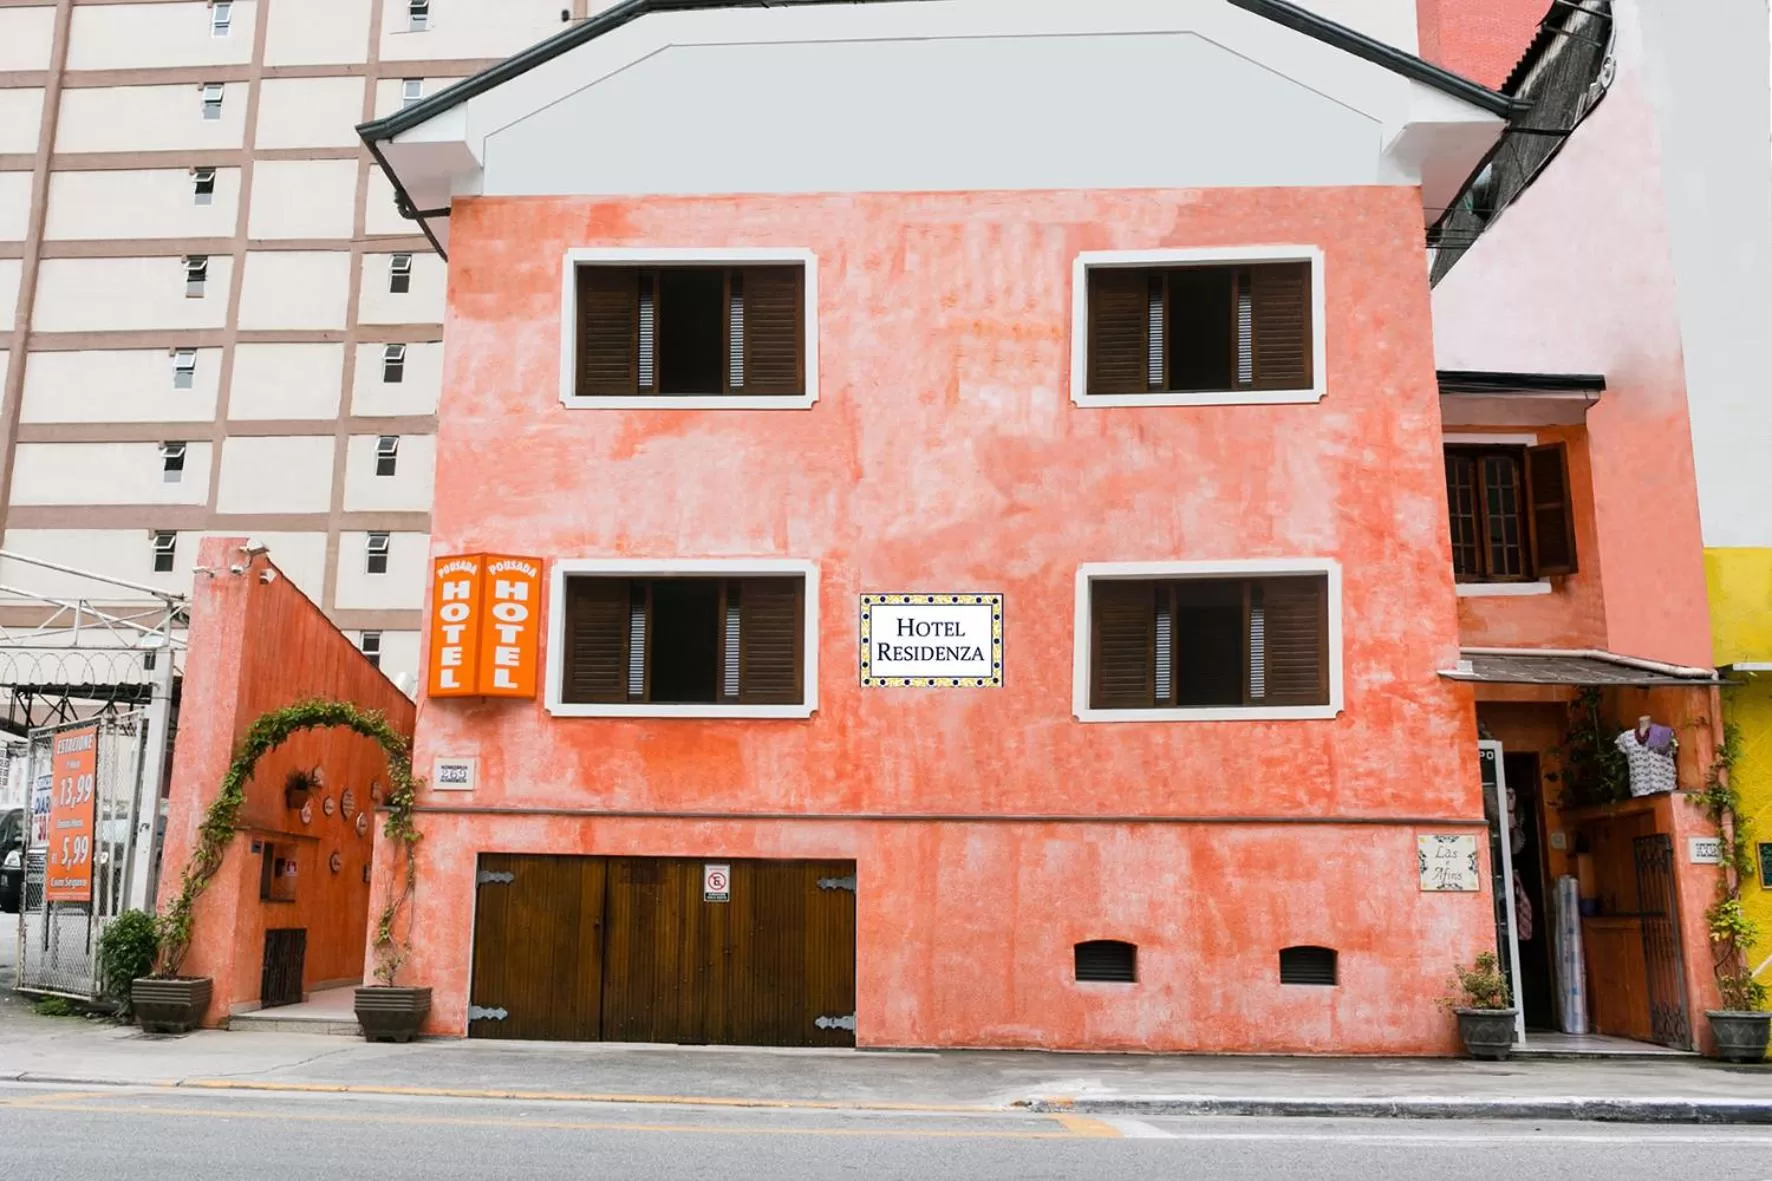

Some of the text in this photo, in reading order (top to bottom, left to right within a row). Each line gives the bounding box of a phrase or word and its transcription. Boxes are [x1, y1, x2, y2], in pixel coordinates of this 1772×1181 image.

[437, 560, 478, 579] POUSADA
[488, 560, 537, 578] POUSADA
[440, 580, 470, 688] HOTEL
[493, 580, 528, 688] HOTEL
[897, 618, 966, 638] HOTEL
[877, 642, 985, 662] RESIDENZA
[60, 773, 92, 809] 13,99
[61, 836, 88, 871] 5,99
